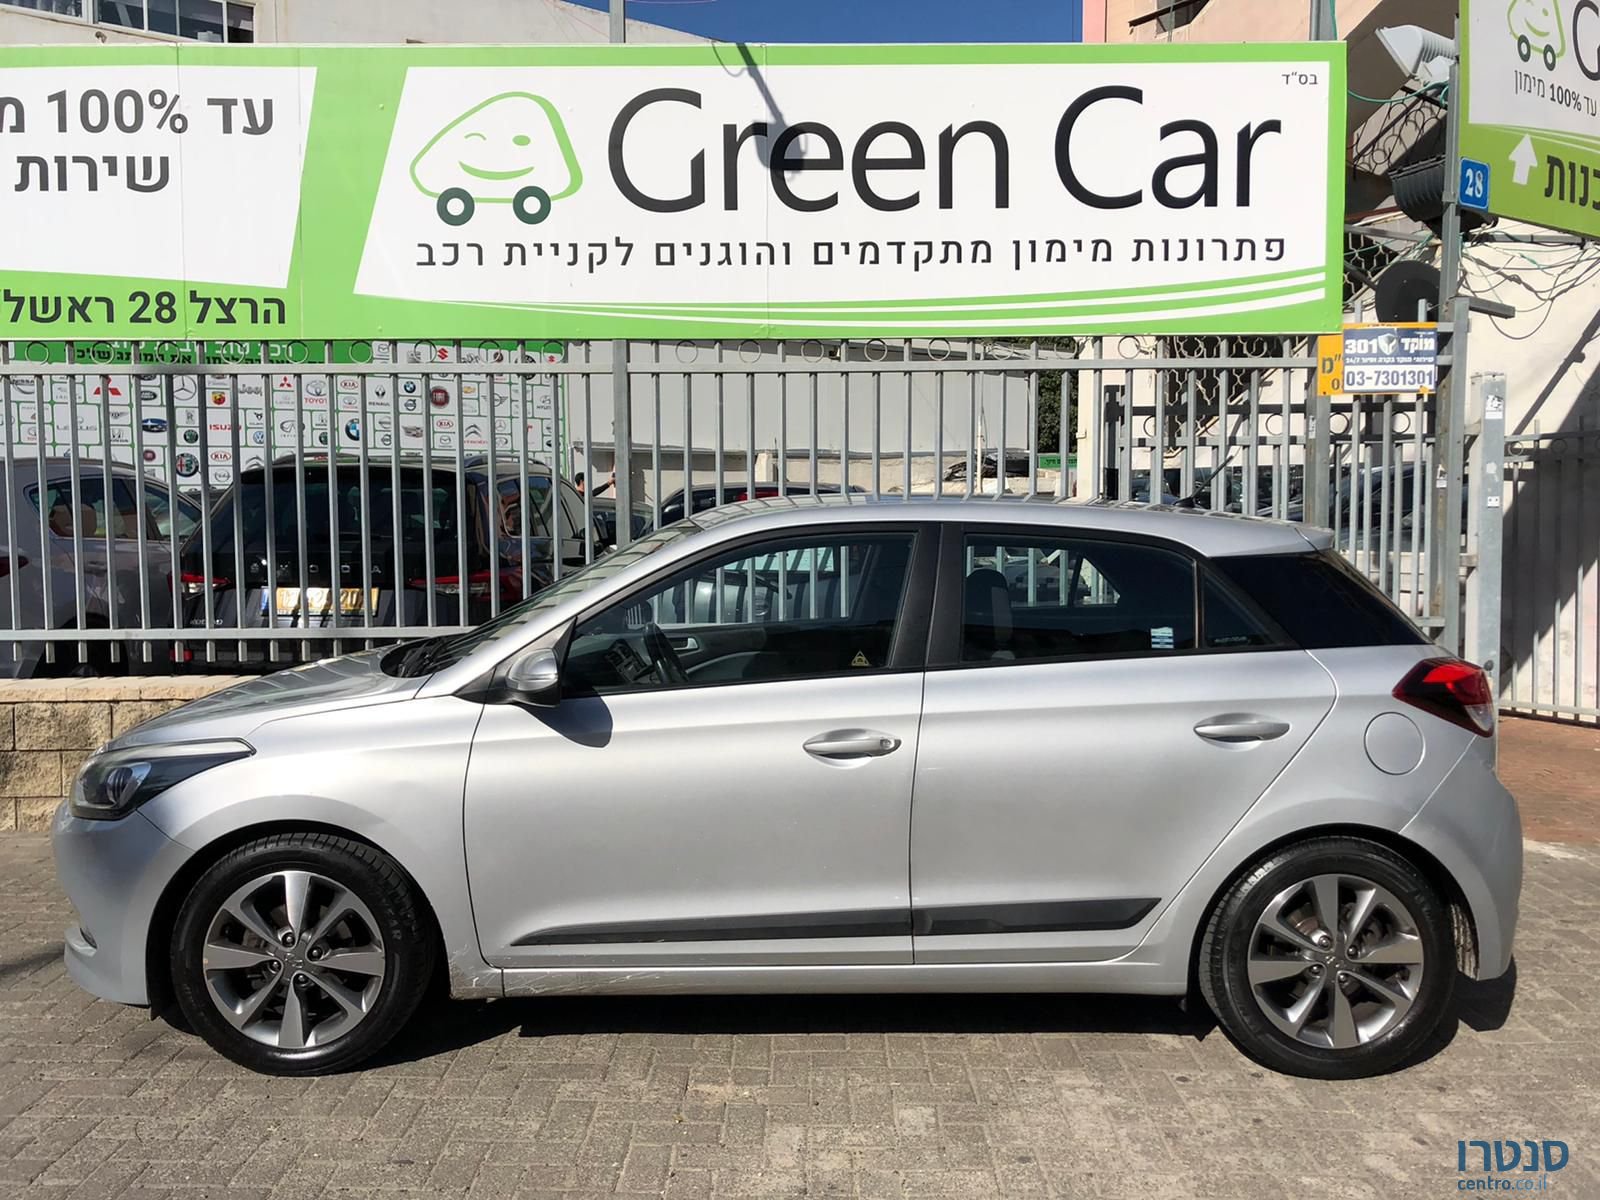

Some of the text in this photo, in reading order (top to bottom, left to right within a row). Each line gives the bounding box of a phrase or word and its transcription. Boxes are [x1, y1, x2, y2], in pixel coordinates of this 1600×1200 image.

[48, 89, 188, 133] 100%
[1514, 69, 1598, 117] עד 100% מימון
[207, 98, 273, 136] עד
[608, 85, 1281, 213] Green Car
[14, 155, 170, 193] שירות
[1465, 168, 1483, 198] 28
[416, 236, 1286, 274] פתרונות מימון מתקדמים והוגנים לקניית רכב
[129, 291, 177, 324] 28
[189, 290, 286, 324] הרצל
[1345, 334, 1435, 354] מוקד 301
[1346, 370, 1433, 387] 03-7301301
